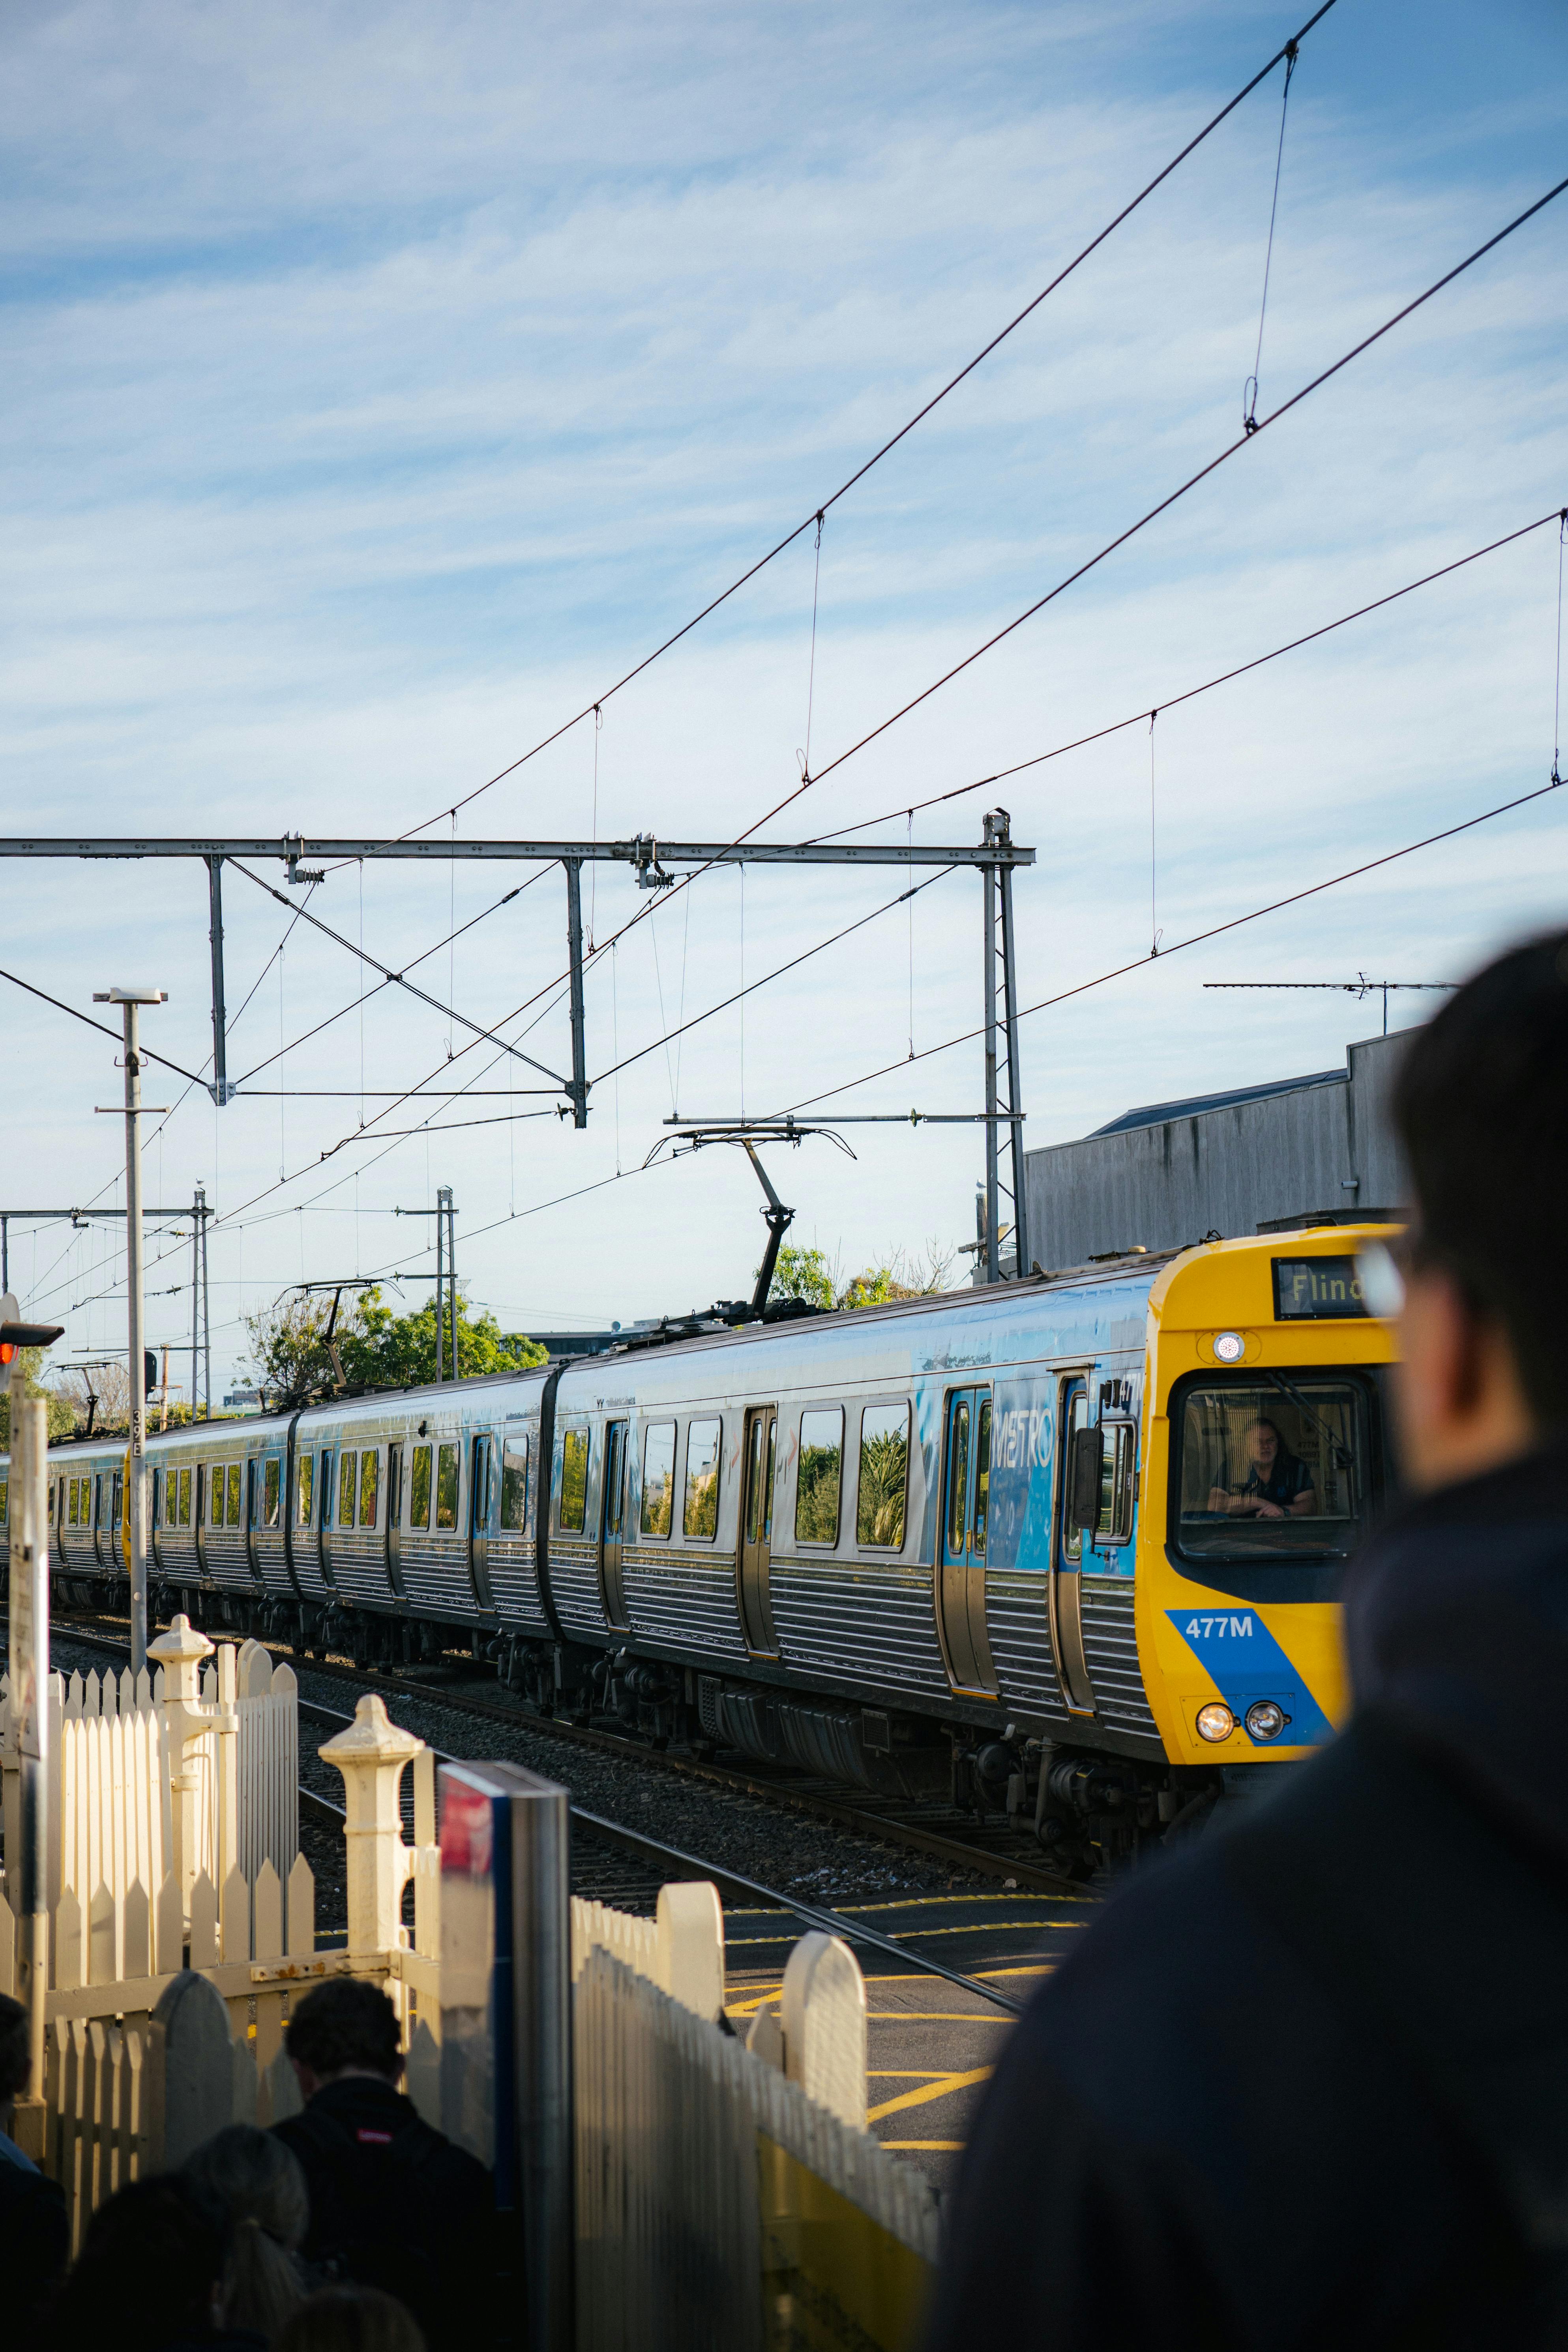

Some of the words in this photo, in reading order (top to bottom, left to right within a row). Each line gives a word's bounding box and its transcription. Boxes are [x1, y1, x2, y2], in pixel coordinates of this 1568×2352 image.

[1293, 1275, 1366, 1301] Flind
[1120, 1373, 1146, 1402] 477M
[992, 1408, 1053, 1468] METRO
[1186, 1616, 1253, 1638] 477M
